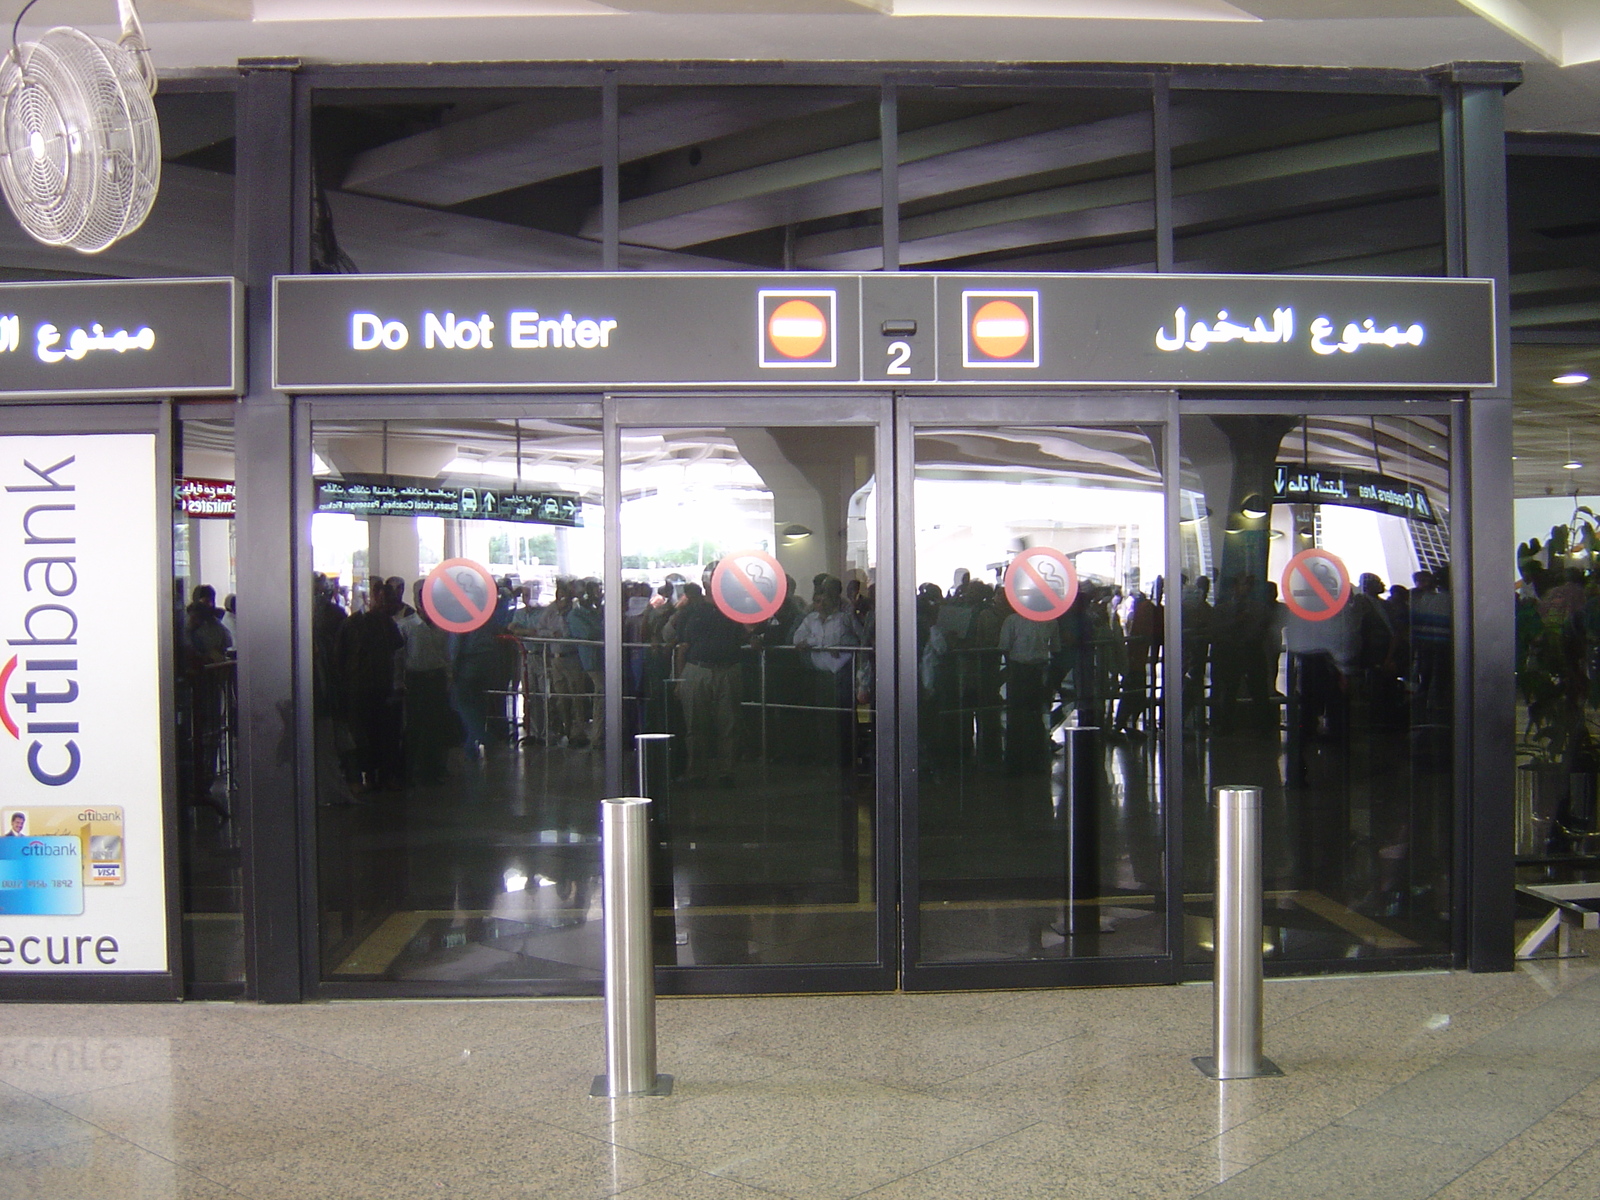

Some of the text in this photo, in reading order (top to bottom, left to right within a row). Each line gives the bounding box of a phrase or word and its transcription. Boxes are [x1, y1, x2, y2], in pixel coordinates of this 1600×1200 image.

[37, 323, 155, 363] ممنوع
[353, 311, 617, 350] Do Not Enter
[1156, 306, 1423, 355] ممنوع الدخول
[886, 341, 911, 375] 2
[2, 454, 81, 786] citibank
[78, 810, 121, 822] citibank
[21, 842, 77, 857] citibank
[97, 868, 116, 876] VISA
